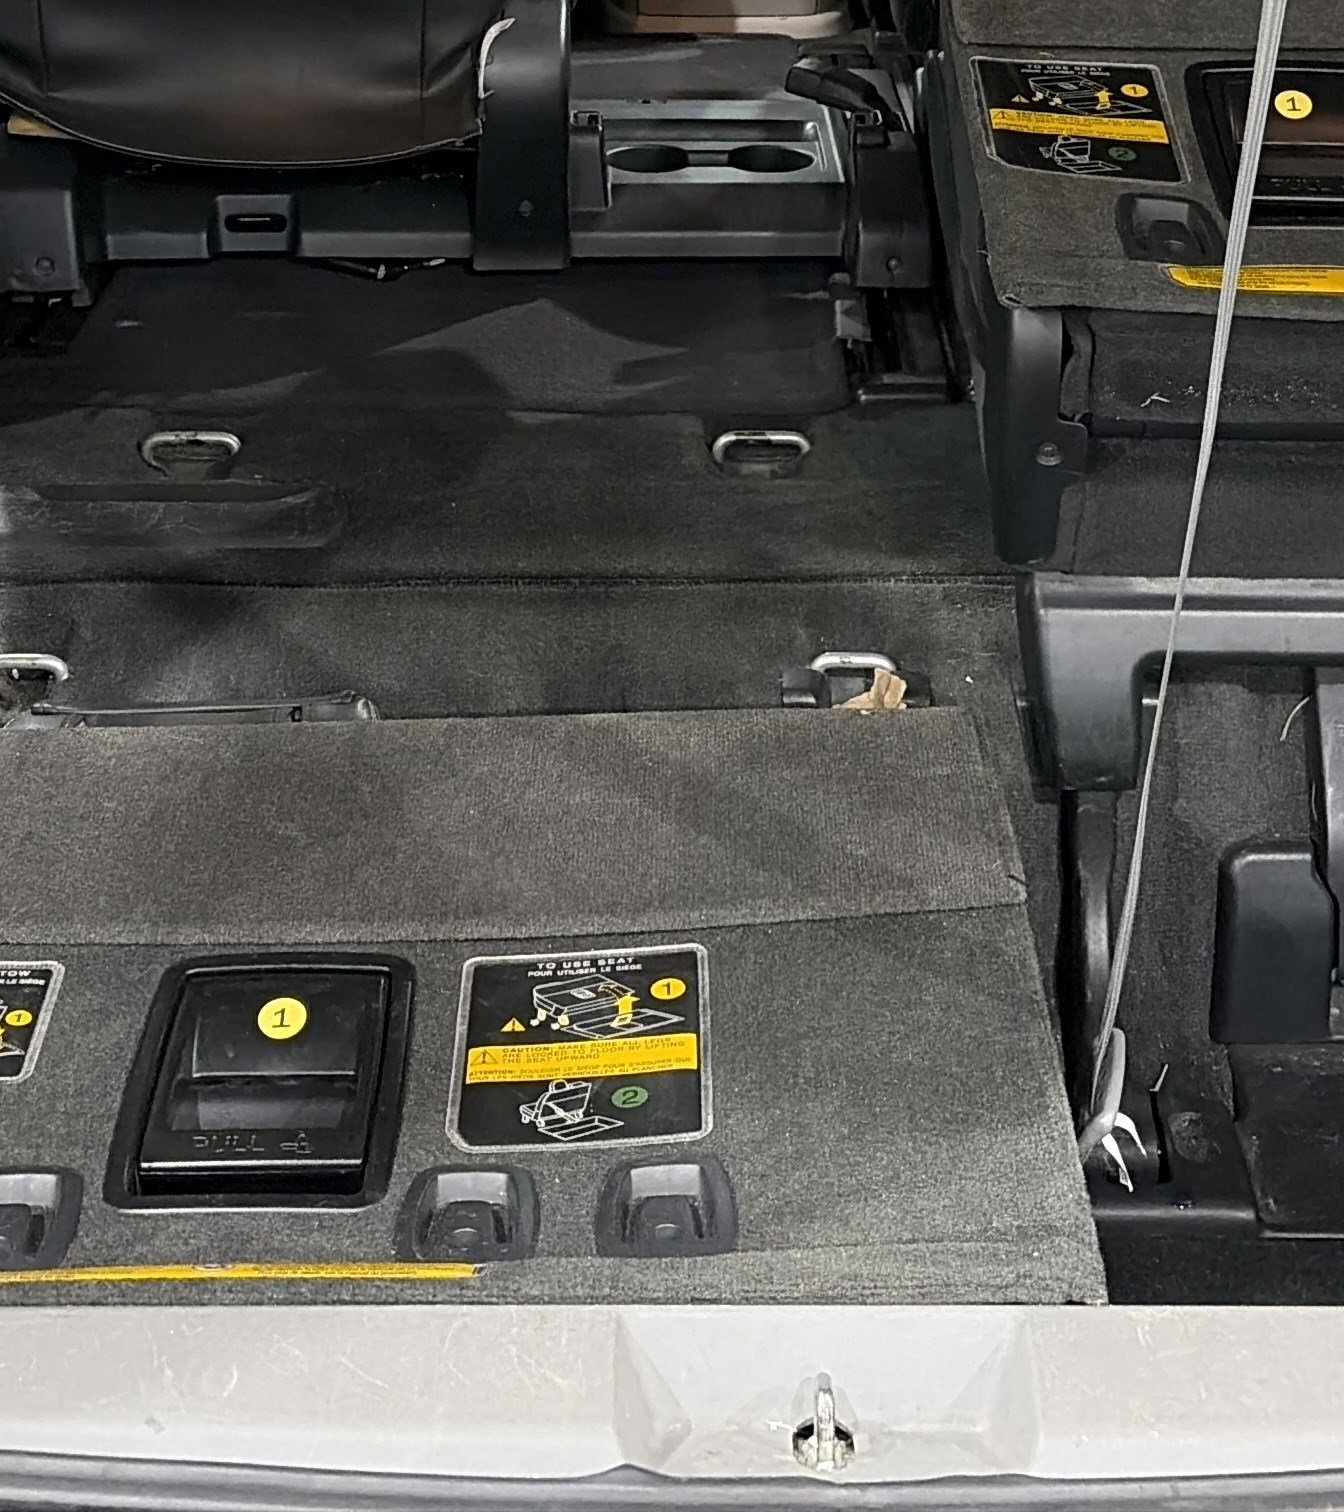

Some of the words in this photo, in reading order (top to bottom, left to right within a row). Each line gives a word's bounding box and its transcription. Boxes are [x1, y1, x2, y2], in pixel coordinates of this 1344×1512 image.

[1286, 96, 1302, 112] 1
[537, 961, 557, 970] TO
[562, 960, 591, 968] USE
[597, 956, 635, 966] SEAT
[527, 970, 553, 978] POUR
[556, 967, 597, 977] UTILISER
[600, 965, 612, 973] LE
[271, 1007, 291, 1029] 1
